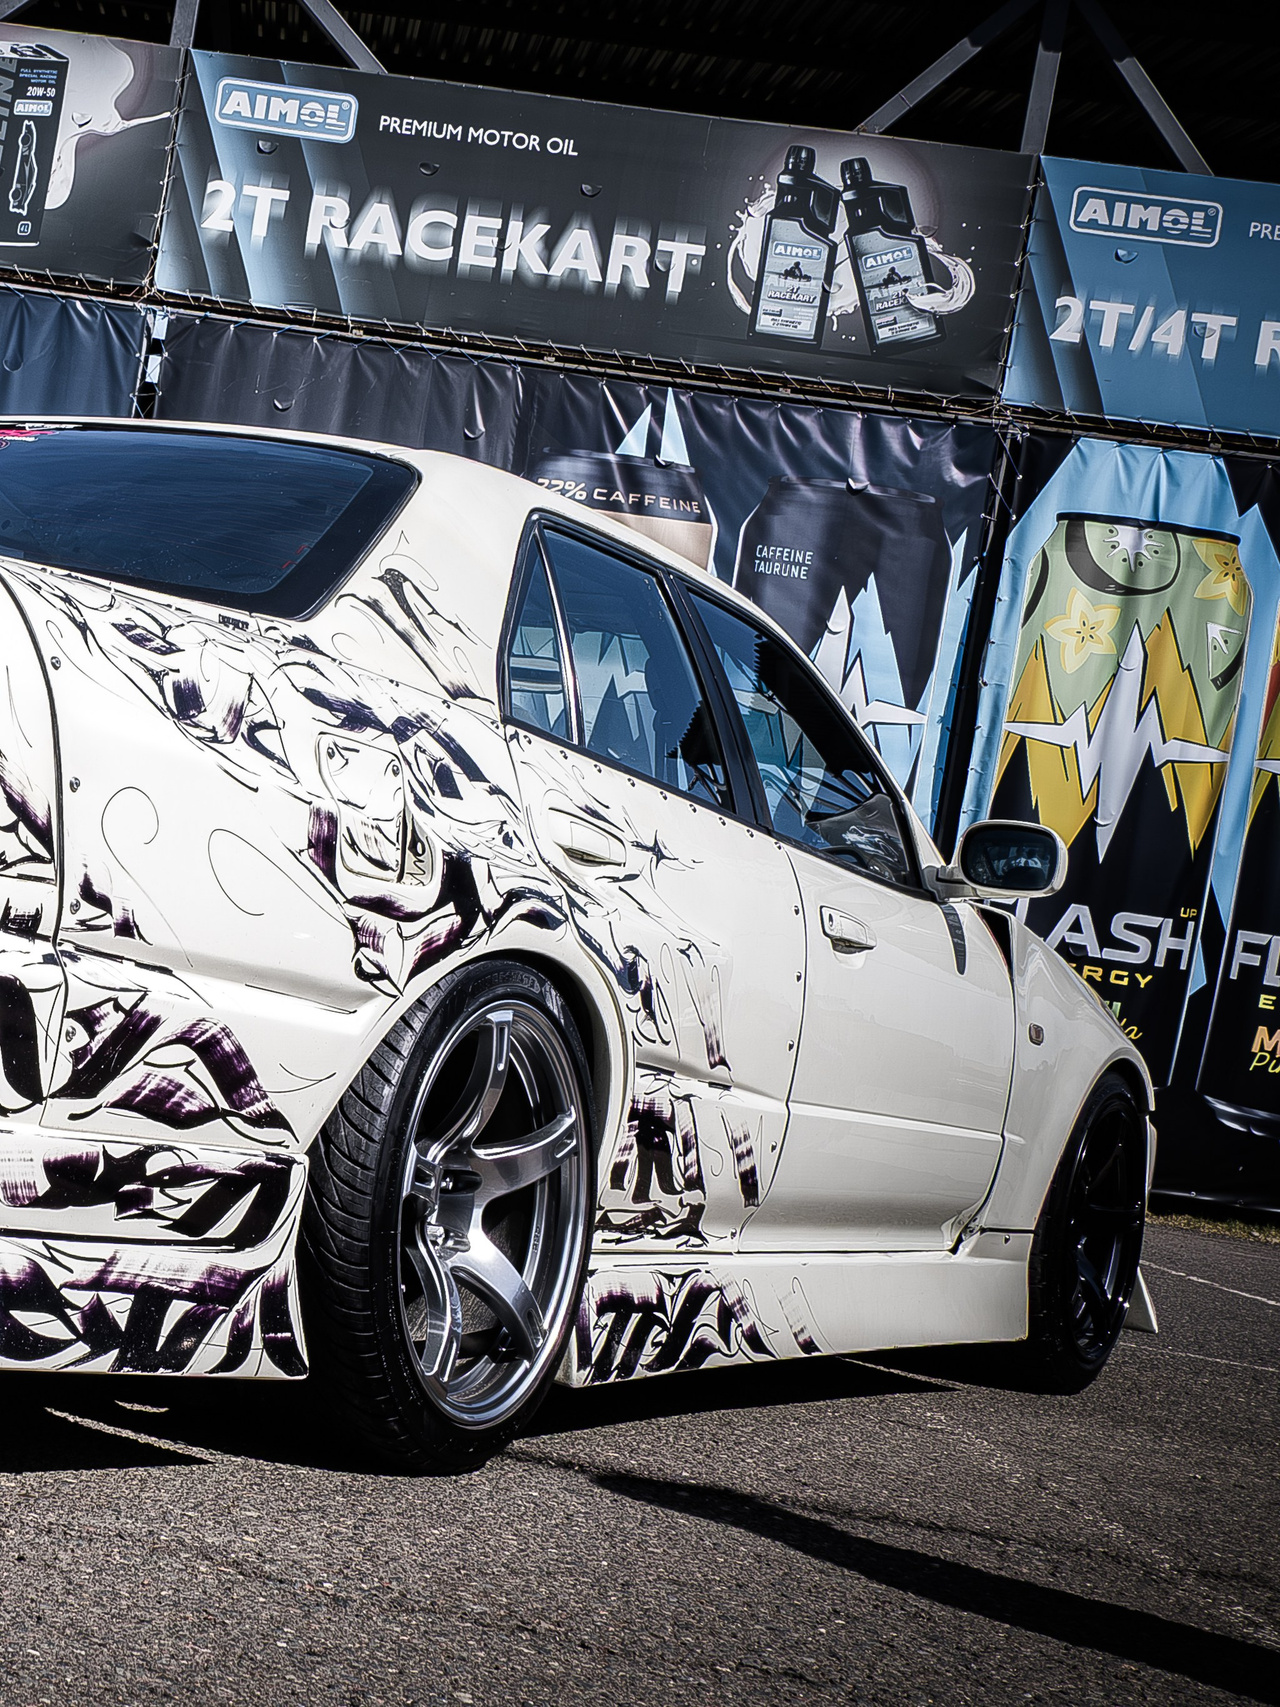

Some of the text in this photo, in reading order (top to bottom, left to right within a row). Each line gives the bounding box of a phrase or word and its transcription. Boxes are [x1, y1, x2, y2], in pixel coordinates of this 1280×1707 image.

[26, 86, 56, 98] 20W-50
[16, 103, 50, 113] AIMOL
[221, 90, 347, 134] AIMOL
[379, 115, 578, 156] PREMIUM MOTOR OIL
[1077, 198, 1212, 238] AIMOL
[200, 179, 706, 294] 2T RACEKART
[774, 244, 821, 260] AIMOL
[866, 247, 912, 268] AIMOL
[767, 290, 817, 304] RACEKART
[1049, 295, 1238, 360] 2T/4T
[593, 488, 701, 514] CAFFEINE
[755, 544, 814, 565] CAFFEINE
[753, 559, 809, 580] TAURUNE
[1180, 907, 1198, 918] UP
[1016, 898, 1195, 970] ASH
[1069, 963, 1153, 988] RGY
